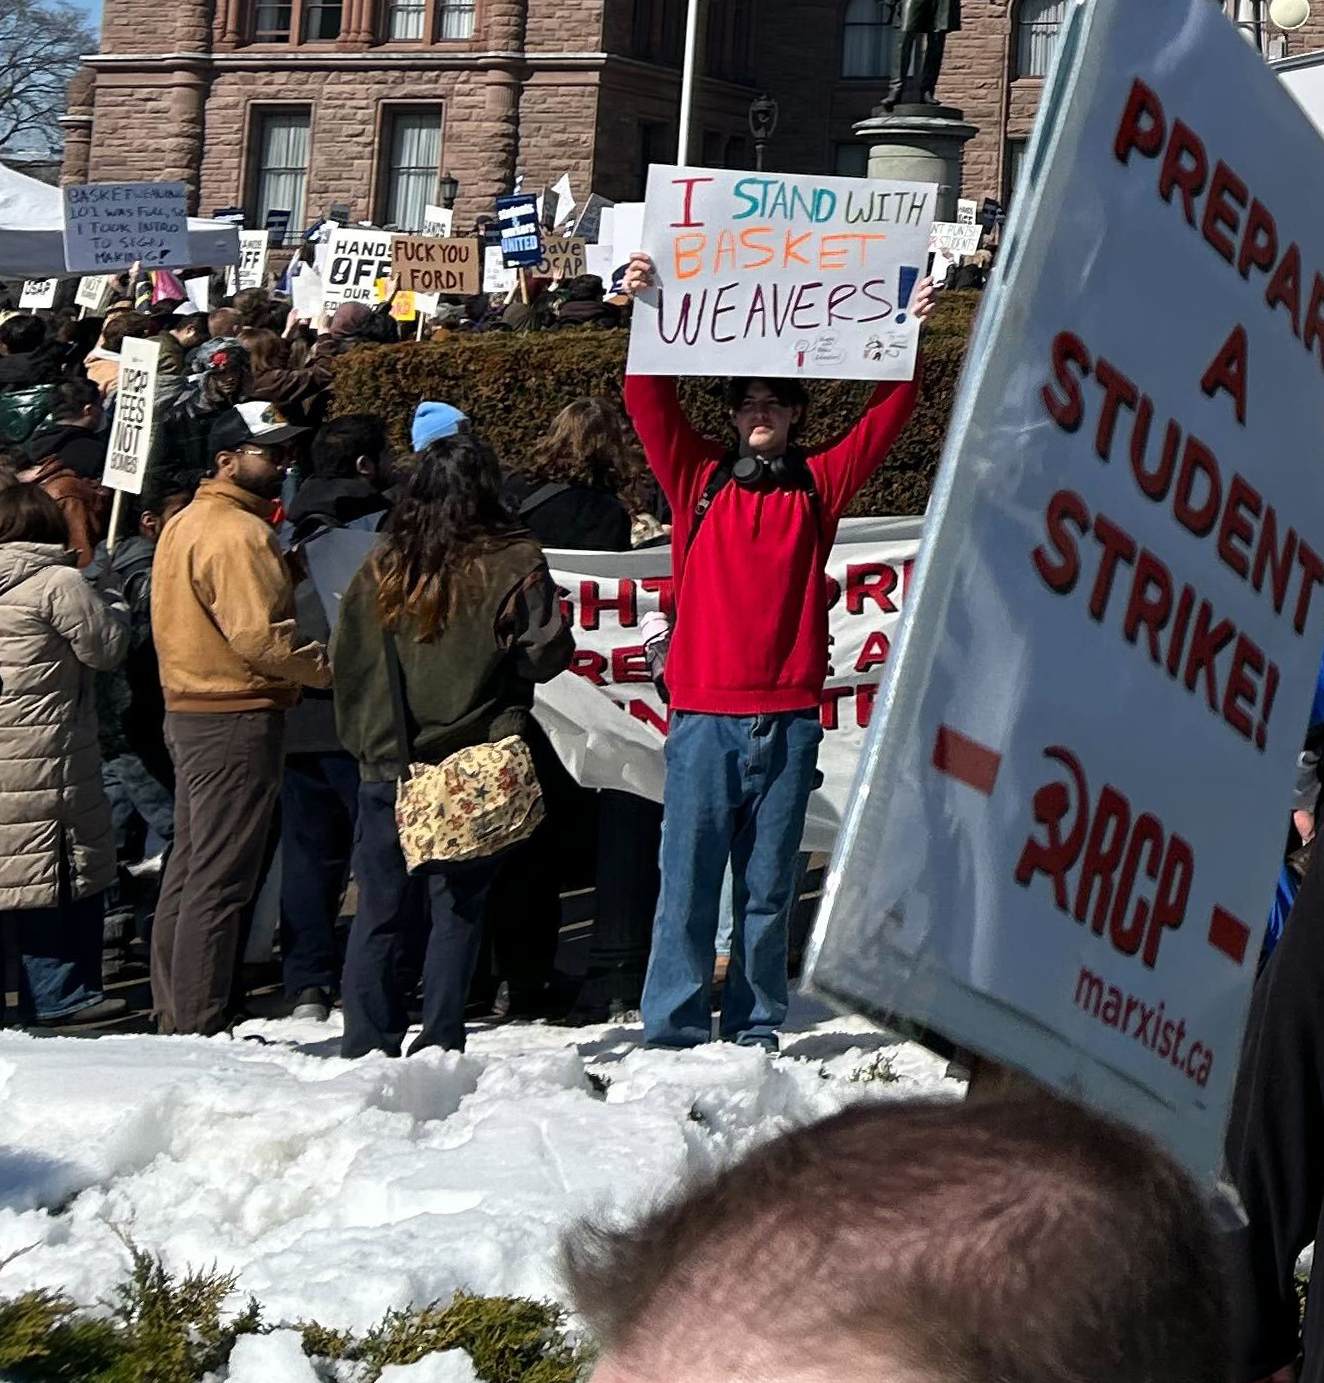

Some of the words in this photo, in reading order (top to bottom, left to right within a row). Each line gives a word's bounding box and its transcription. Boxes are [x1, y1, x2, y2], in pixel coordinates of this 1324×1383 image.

[670, 177, 714, 228] I
[732, 177, 837, 223] STAND
[844, 190, 928, 227] WITH
[92, 236, 111, 250] TO
[394, 240, 435, 263] FUCK
[437, 245, 469, 264] YOU
[501, 234, 539, 254] UNITED
[673, 227, 887, 280] BASKET
[343, 288, 370, 300] OUR
[410, 268, 465, 292] FORD!
[657, 265, 919, 345] WEAVERS!
[121, 367, 149, 395] DROP
[1200, 323, 1250, 423] A
[118, 393, 146, 424] FEES
[113, 419, 145, 456] NOT
[110, 451, 139, 475] BOMBS
[1030, 486, 1280, 754] STRIKE!
[1073, 782, 1194, 971] RCP
[1074, 966, 1214, 1089] marxist.ca
